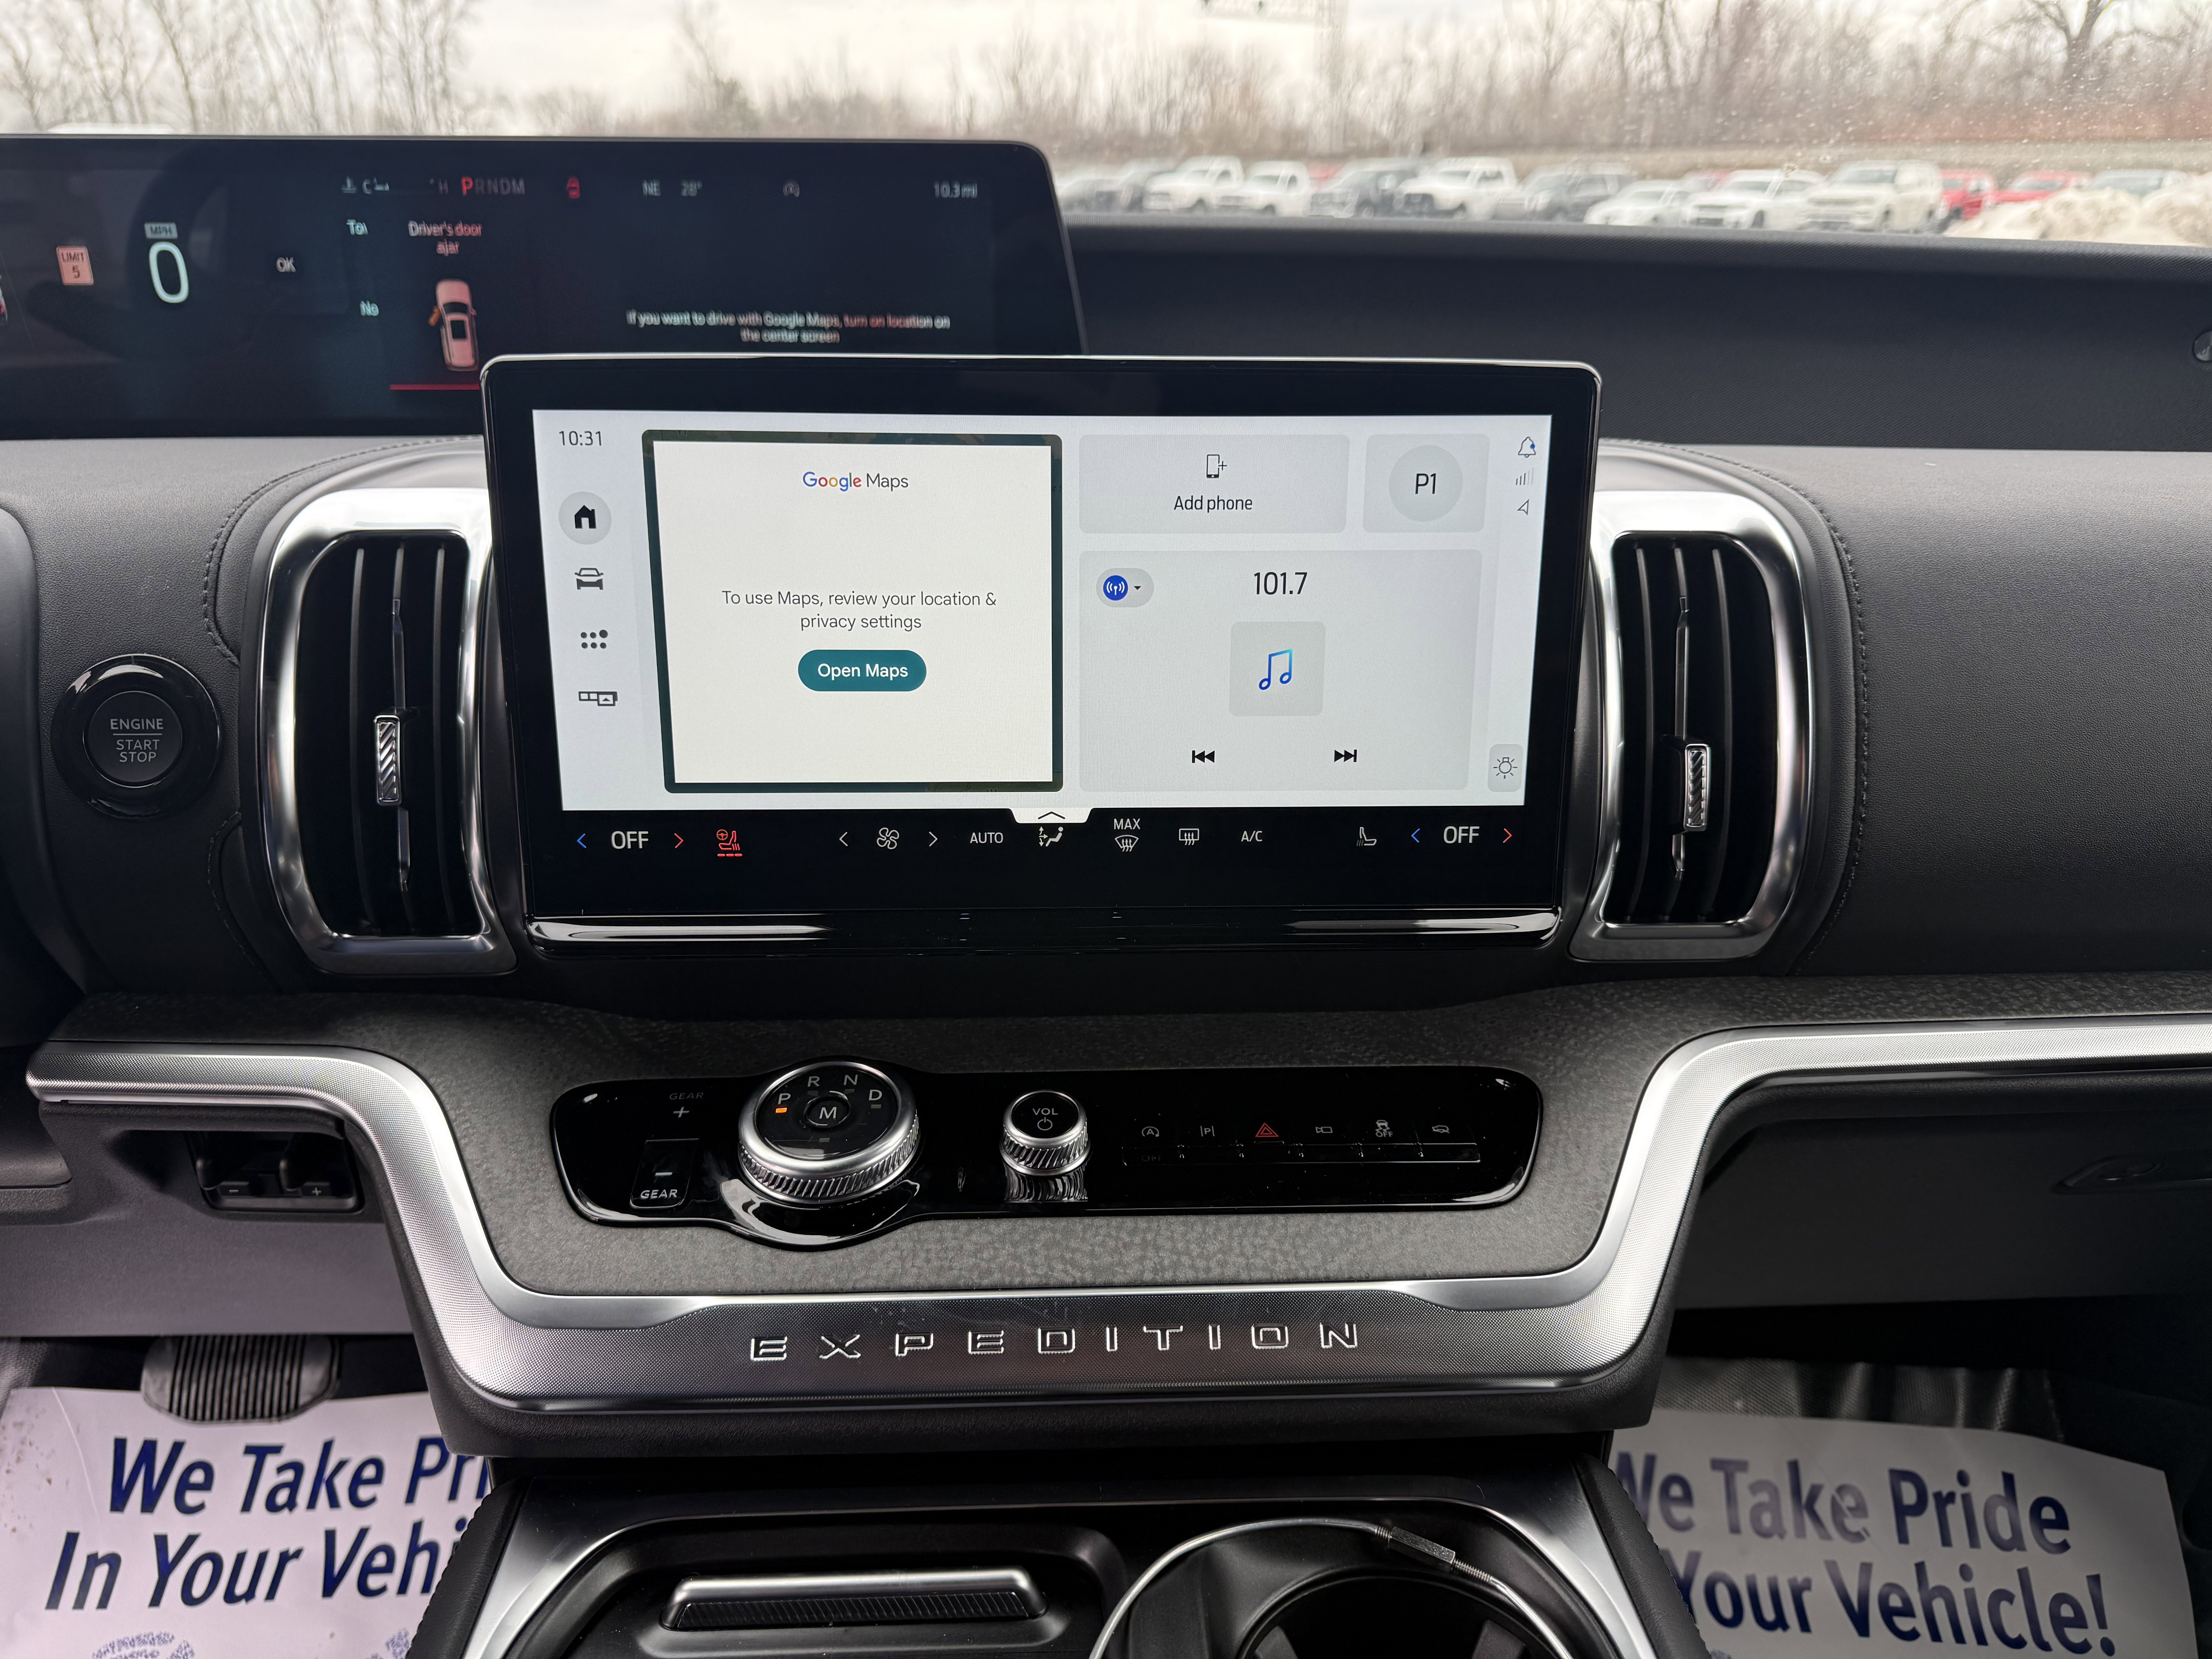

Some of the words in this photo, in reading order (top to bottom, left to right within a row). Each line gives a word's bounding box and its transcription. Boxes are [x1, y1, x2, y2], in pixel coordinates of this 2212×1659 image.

[642, 179, 661, 196] NE
[934, 180, 960, 198] 10.3
[149, 225, 172, 234] MPH
[408, 220, 453, 237] Driver's
[454, 220, 482, 237] door
[436, 238, 459, 256] ajar
[61, 252, 84, 263] LIMIT
[276, 257, 296, 273] OK
[72, 265, 81, 279] 5
[149, 241, 189, 303] 0
[626, 309, 637, 325] If
[637, 311, 660, 328] you
[660, 311, 691, 325] want
[692, 311, 705, 326] to
[706, 310, 736, 326] drive
[736, 311, 762, 326] with
[763, 311, 805, 329] Google
[806, 311, 842, 329] Maps,
[843, 313, 867, 328] turn
[869, 314, 885, 328] on
[886, 313, 933, 328] location
[934, 315, 950, 329] on
[740, 327, 760, 342] the
[559, 431, 602, 447] 10:31
[803, 471, 862, 492] Google
[866, 473, 908, 491] Maps
[1415, 473, 1436, 495] P1
[1174, 495, 1203, 510] Add
[1207, 495, 1253, 514] phone
[1254, 572, 1308, 596] 101.7
[721, 590, 740, 605] To
[745, 594, 773, 605] use
[778, 591, 823, 608] Maps,
[829, 591, 878, 605] review
[882, 595, 916, 609] your
[921, 591, 981, 606] location
[986, 592, 997, 606] &
[801, 613, 856, 631] privacy
[861, 614, 922, 632] settings
[817, 663, 861, 681] Open
[866, 663, 908, 682] Maps
[110, 718, 164, 730] ENGINE
[116, 739, 160, 750] START
[119, 752, 156, 763] STOP
[1113, 818, 1141, 830] MAX
[611, 830, 649, 850] OFF
[970, 832, 1004, 844] AUTO
[1241, 830, 1263, 842] A/C
[1443, 826, 1480, 844] OFF
[807, 1075, 820, 1087] R
[843, 1074, 859, 1086] N
[669, 1092, 704, 1100] GEAR
[778, 1092, 792, 1105] P
[868, 1089, 883, 1101] D
[820, 1106, 837, 1120] M
[1032, 1107, 1059, 1116] VOL
[640, 1188, 678, 1199] GEAR
[750, 1322, 1358, 1362] EXPEDITION
[109, 1436, 215, 1516] We
[240, 1437, 386, 1514] Take
[1709, 1457, 1870, 1544] Take
[1887, 1467, 2072, 1555] Pride
[45, 1531, 123, 1611] In
[147, 1533, 304, 1609] Your
[1823, 1560, 2117, 1657] Vehicle!
